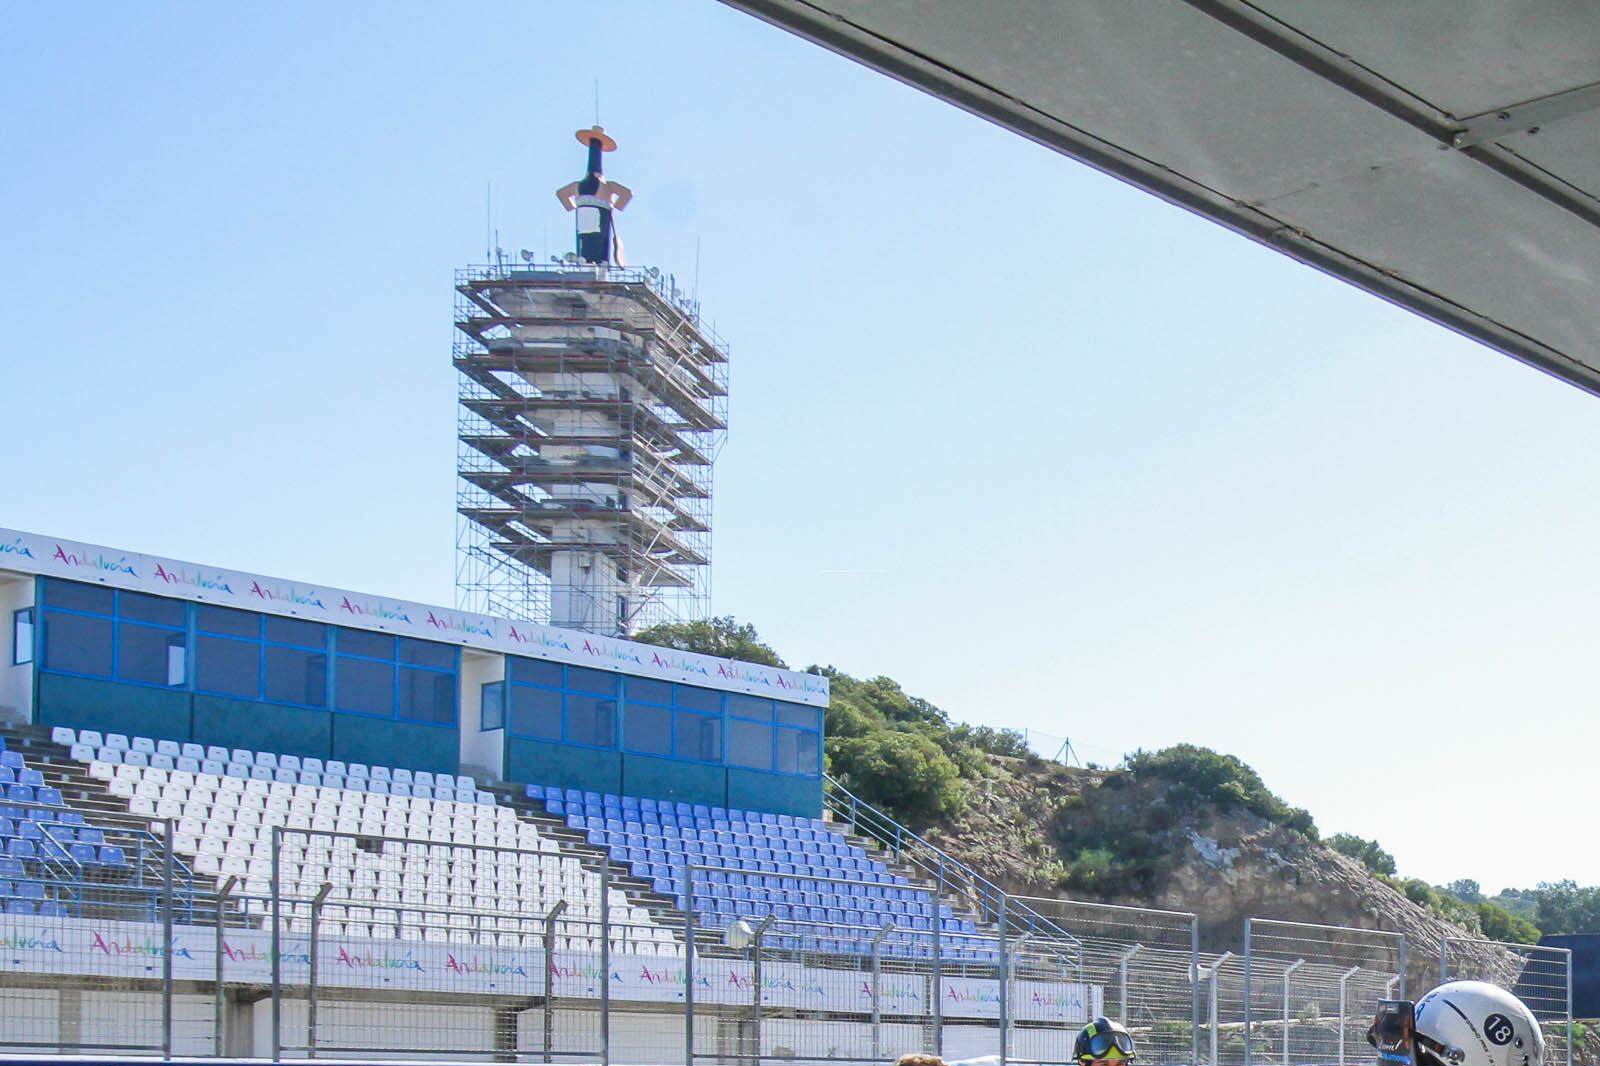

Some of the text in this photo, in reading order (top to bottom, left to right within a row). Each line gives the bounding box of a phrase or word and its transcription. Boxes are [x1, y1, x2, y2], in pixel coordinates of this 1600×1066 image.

[90, 930, 195, 960] Andaluía
[549, 958, 624, 983] Andalua
[640, 965, 711, 988] Andaluía
[862, 981, 919, 1001] Adalucía
[1488, 1016, 1511, 1042] 18
